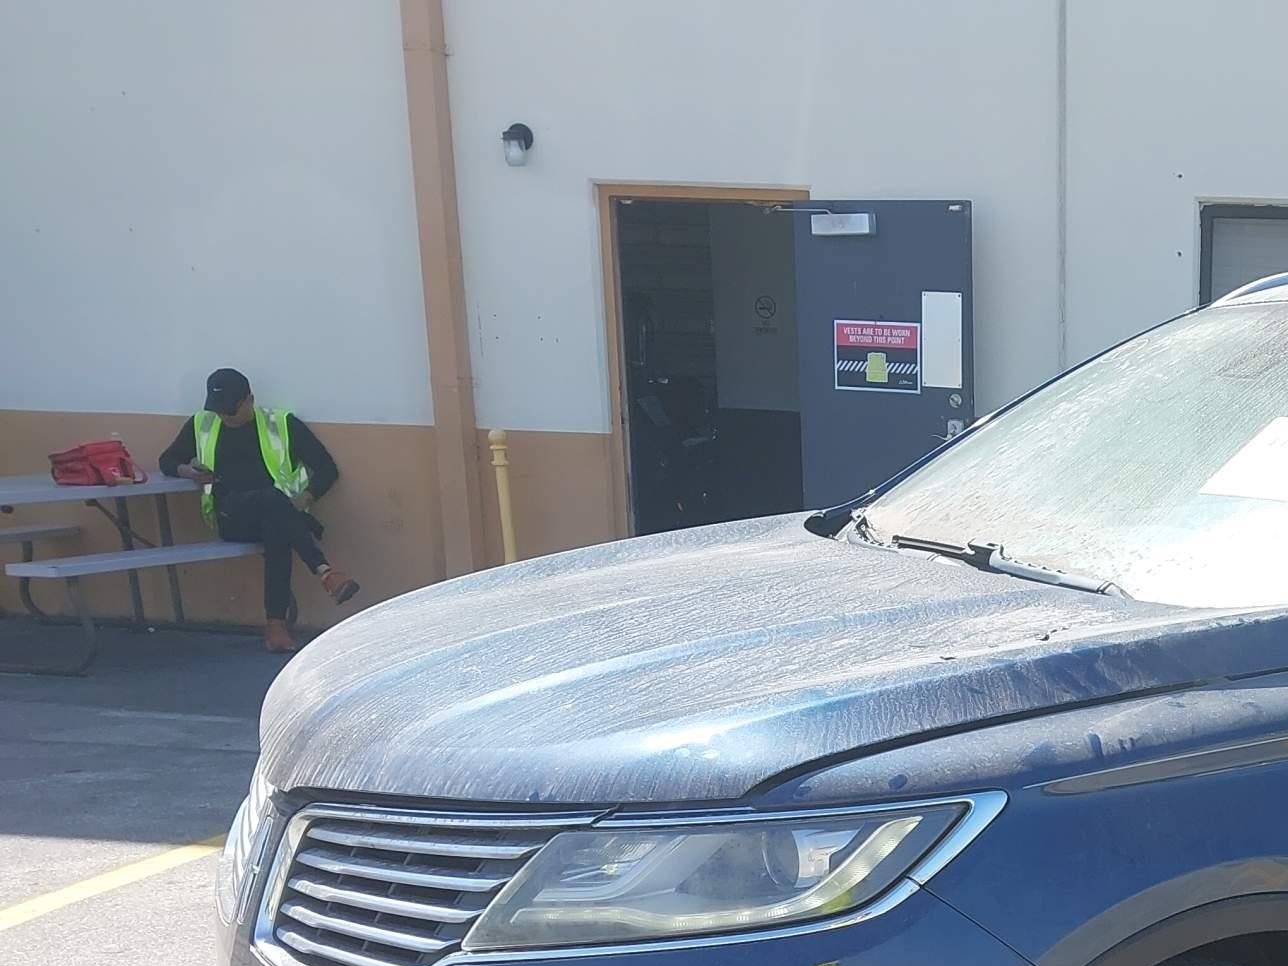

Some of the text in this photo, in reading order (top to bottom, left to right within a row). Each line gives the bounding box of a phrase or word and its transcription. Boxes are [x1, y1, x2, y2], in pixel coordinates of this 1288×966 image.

[843, 327, 862, 335] VESTS
[862, 328, 874, 336] ARE
[875, 328, 883, 336] TO
[892, 329, 911, 337] WORN
[849, 335, 905, 345] BEYOND THIS POINT
